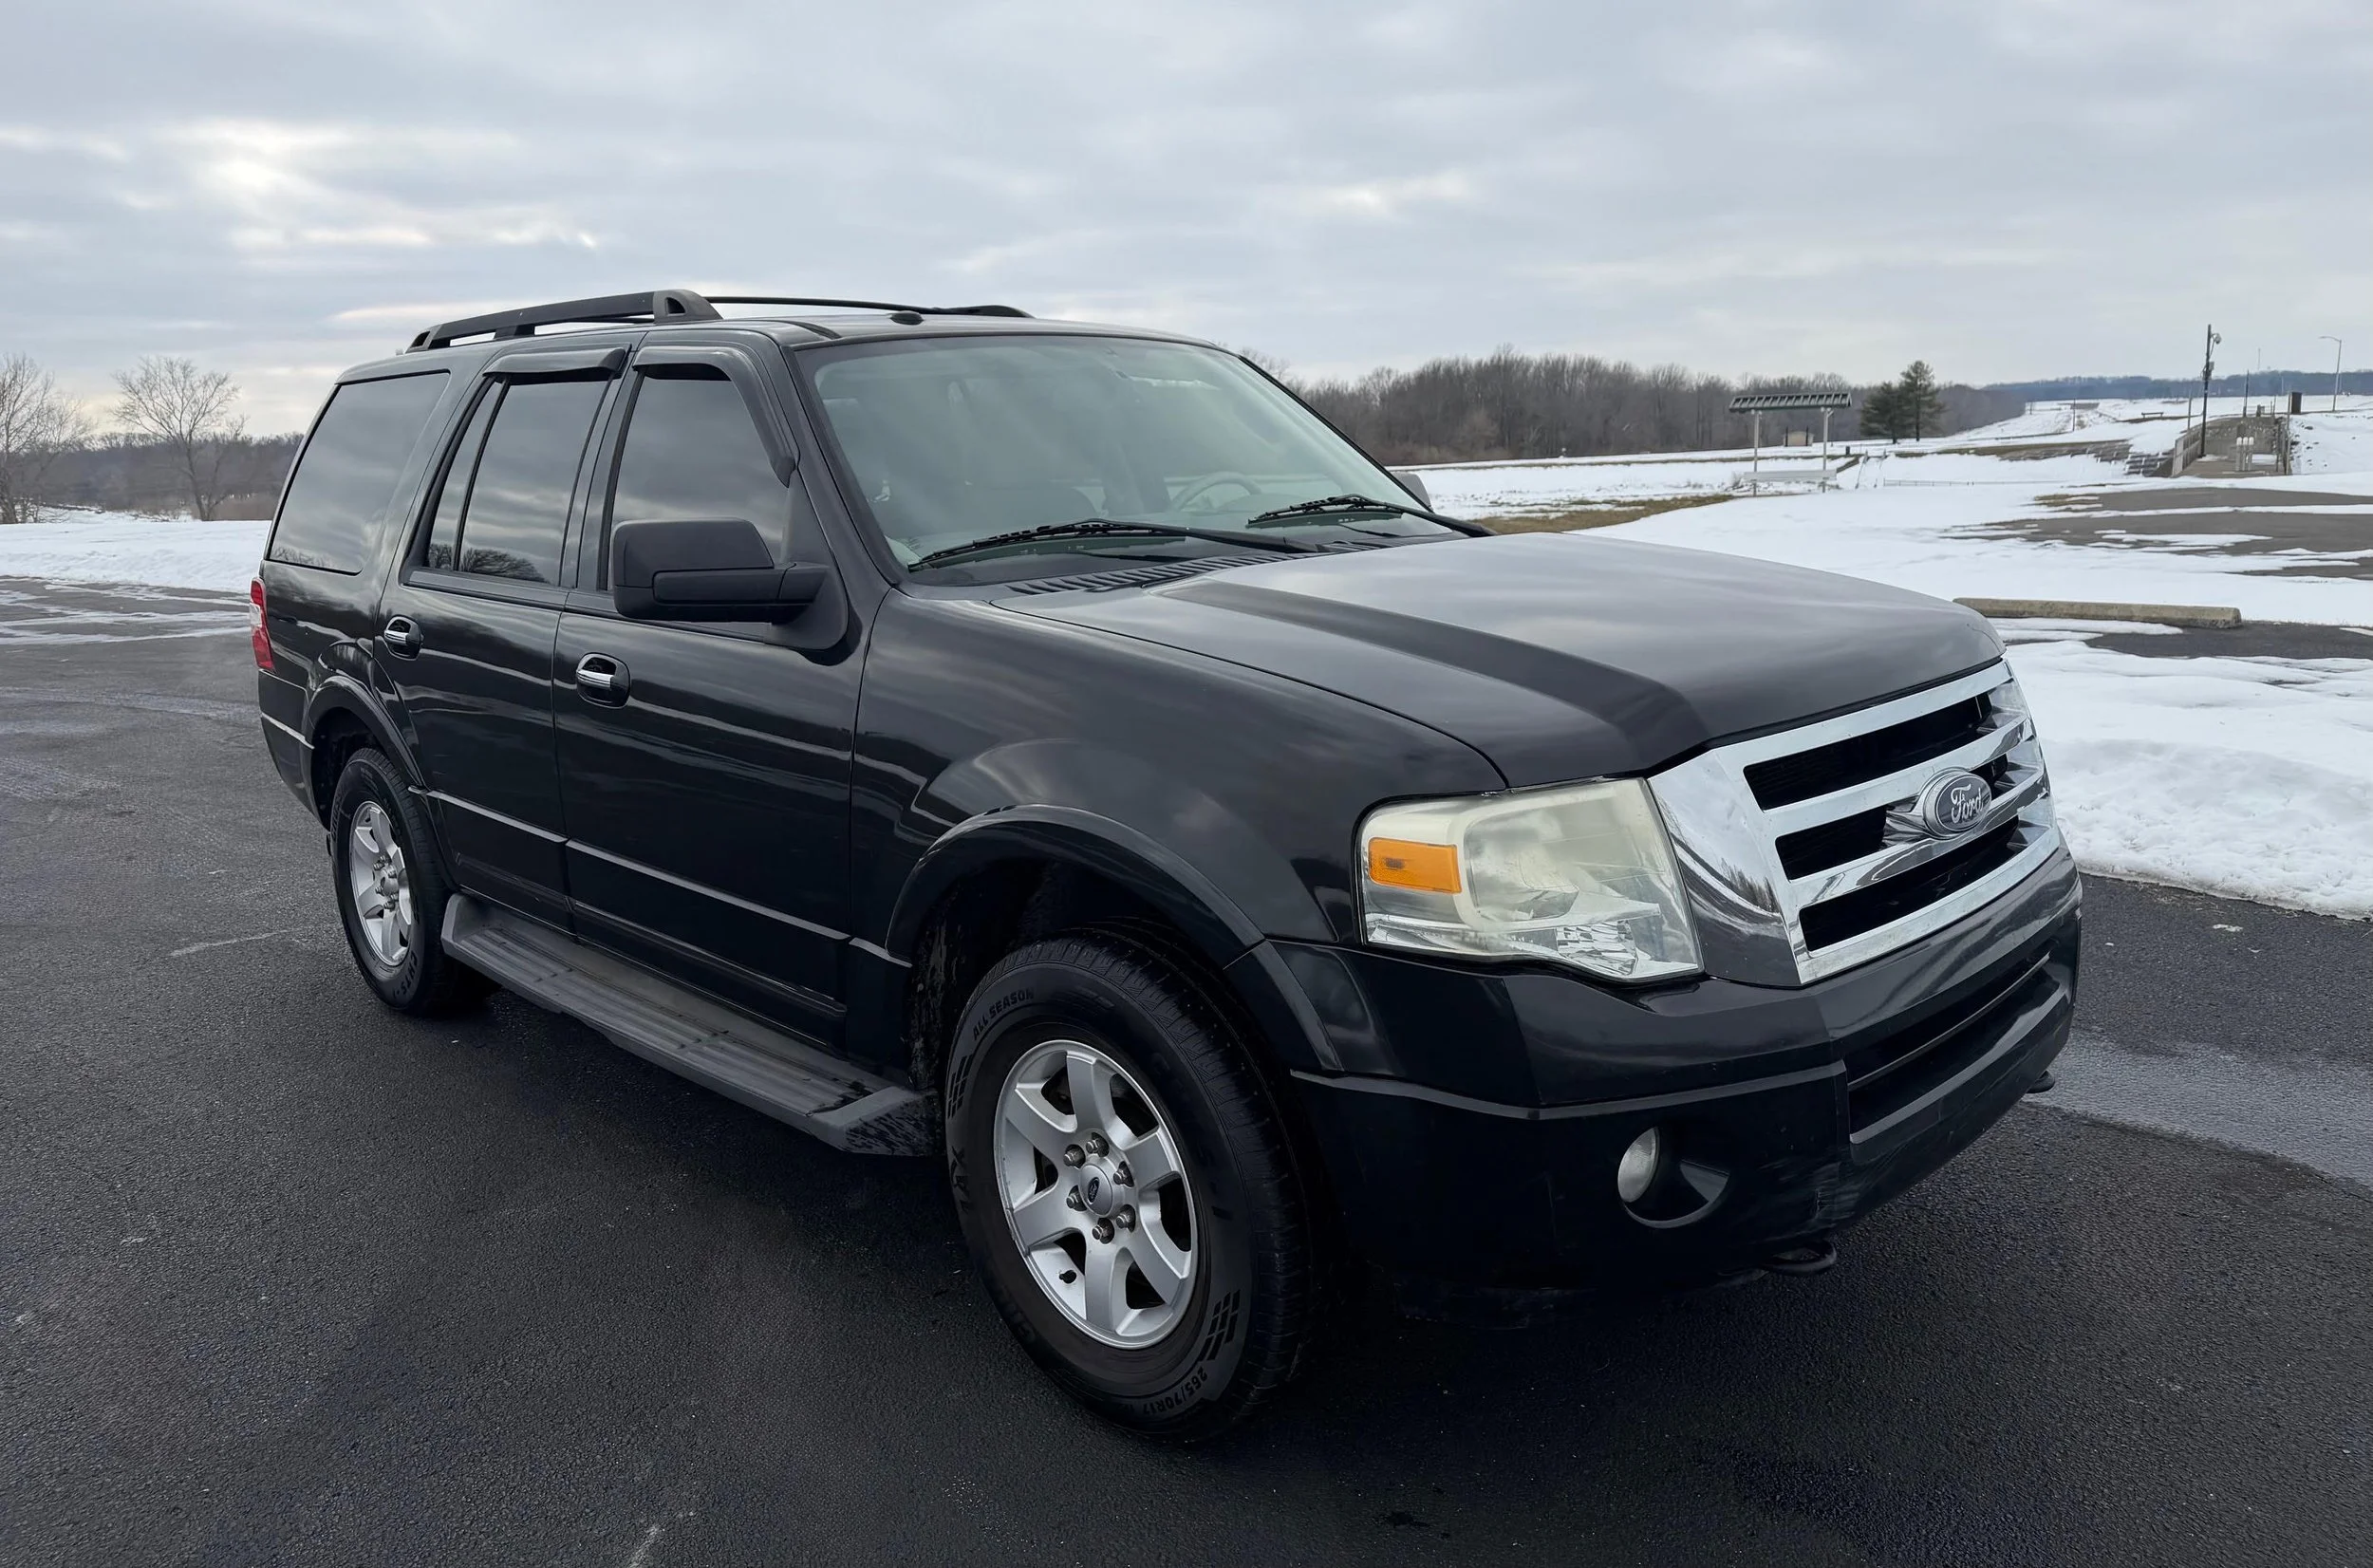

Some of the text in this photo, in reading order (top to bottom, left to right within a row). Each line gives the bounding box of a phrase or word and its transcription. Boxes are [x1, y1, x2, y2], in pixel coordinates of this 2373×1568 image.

[1950, 783, 1984, 824] Ford
[973, 988, 1035, 1041] ALL SEASON
[1143, 1366, 1208, 1415] 265/70R17
